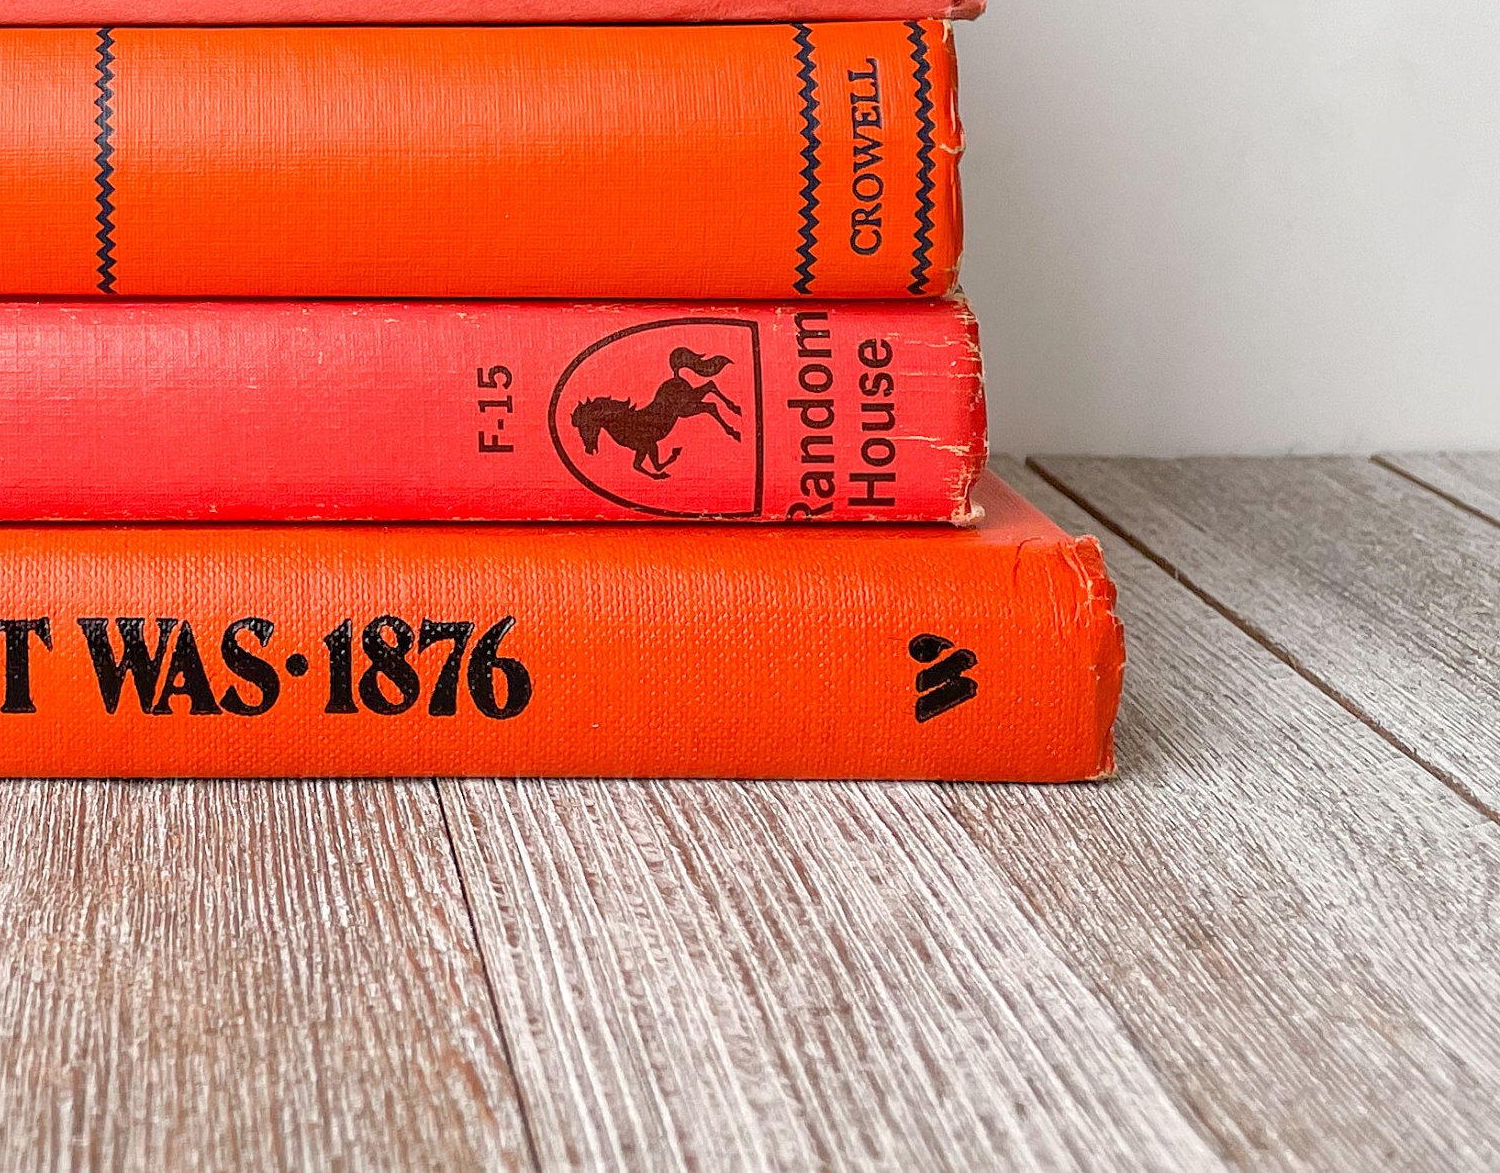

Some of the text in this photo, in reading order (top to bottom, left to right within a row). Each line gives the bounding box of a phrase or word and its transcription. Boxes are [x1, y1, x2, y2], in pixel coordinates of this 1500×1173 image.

[848, 59, 883, 255] CROWELL
[478, 366, 513, 452] F-15
[849, 339, 895, 506] House
